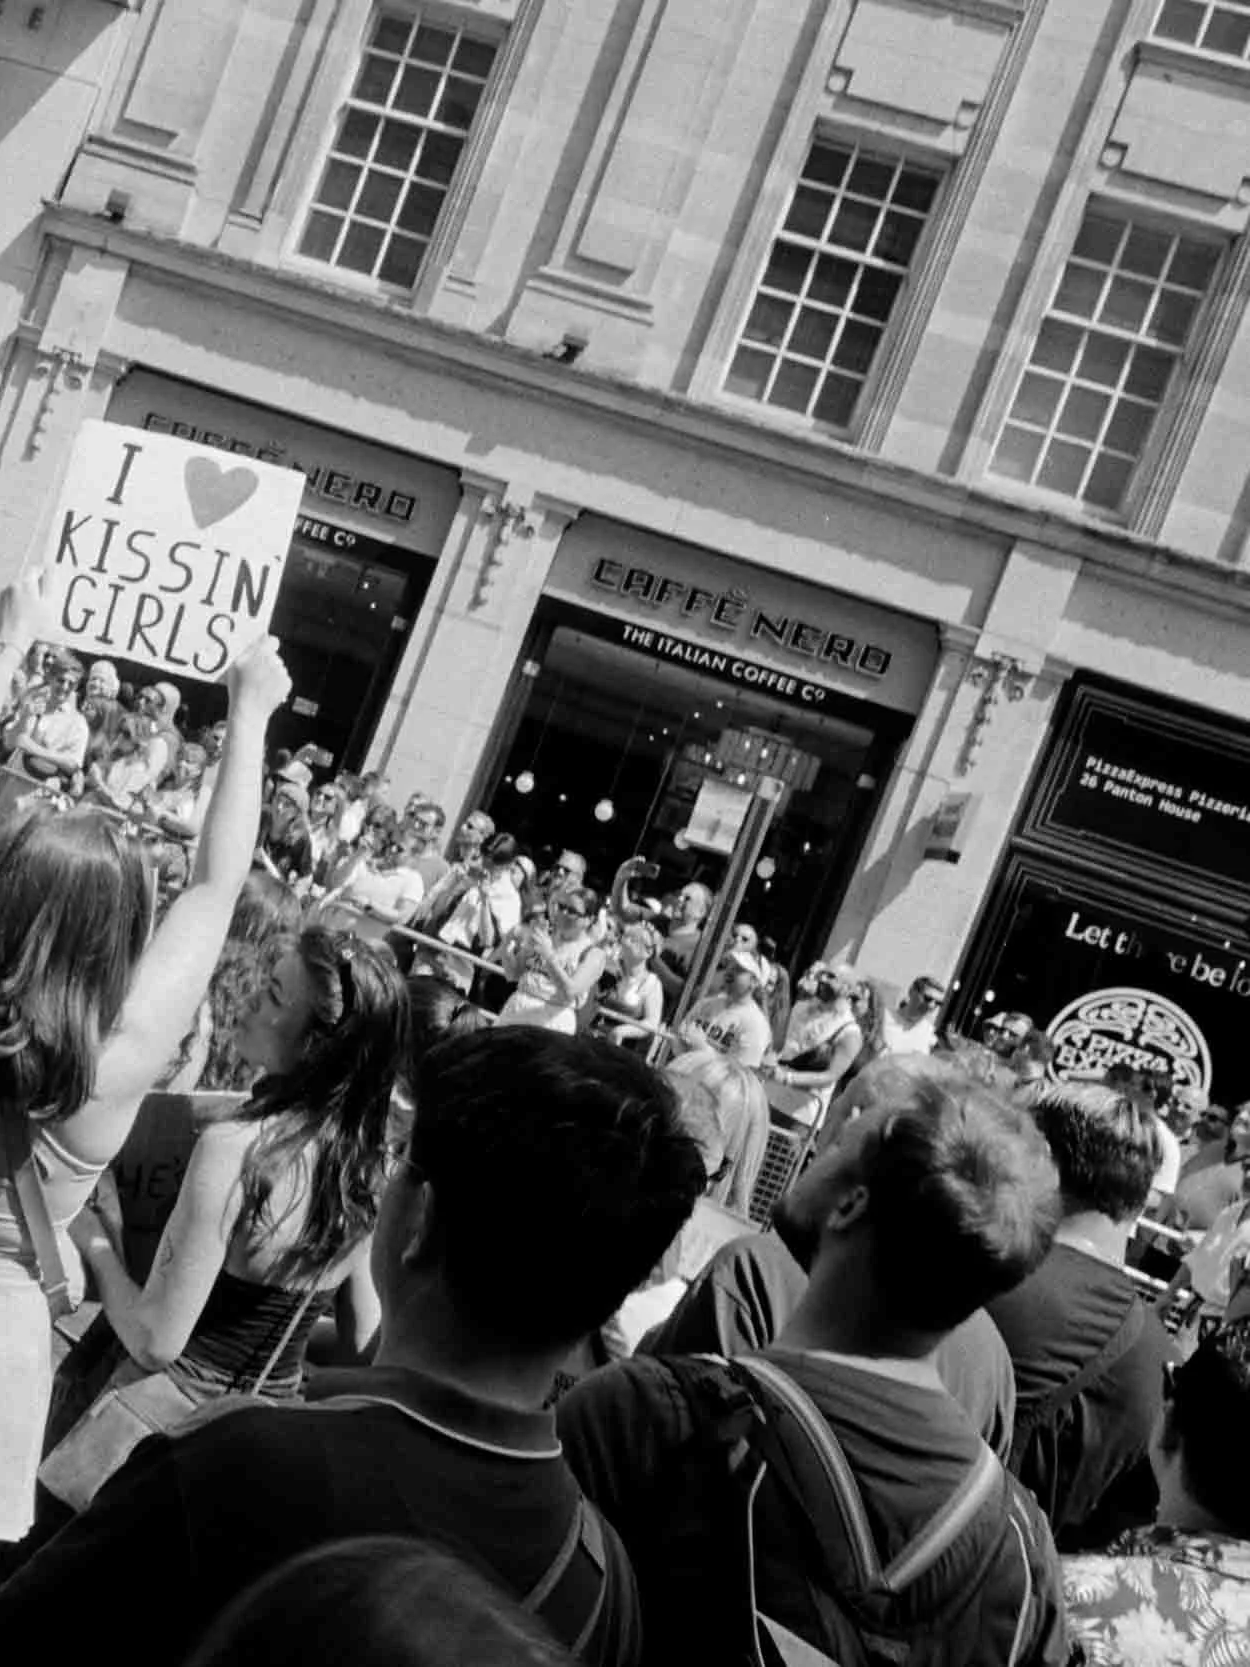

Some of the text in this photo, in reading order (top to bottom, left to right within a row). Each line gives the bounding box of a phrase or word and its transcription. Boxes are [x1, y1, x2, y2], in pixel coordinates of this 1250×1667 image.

[105, 443, 142, 504] I
[62, 574, 235, 674] GIRLS
[751, 611, 893, 677] NERO
[622, 625, 652, 648] THE
[657, 635, 727, 672] ITALIAN
[731, 661, 797, 696] COFFEE
[1086, 755, 1183, 799] PizzaExpress
[1103, 779, 1154, 807] Panton
[1158, 799, 1202, 823] House
[1065, 911, 1112, 949] Let
[1190, 953, 1226, 987] be
